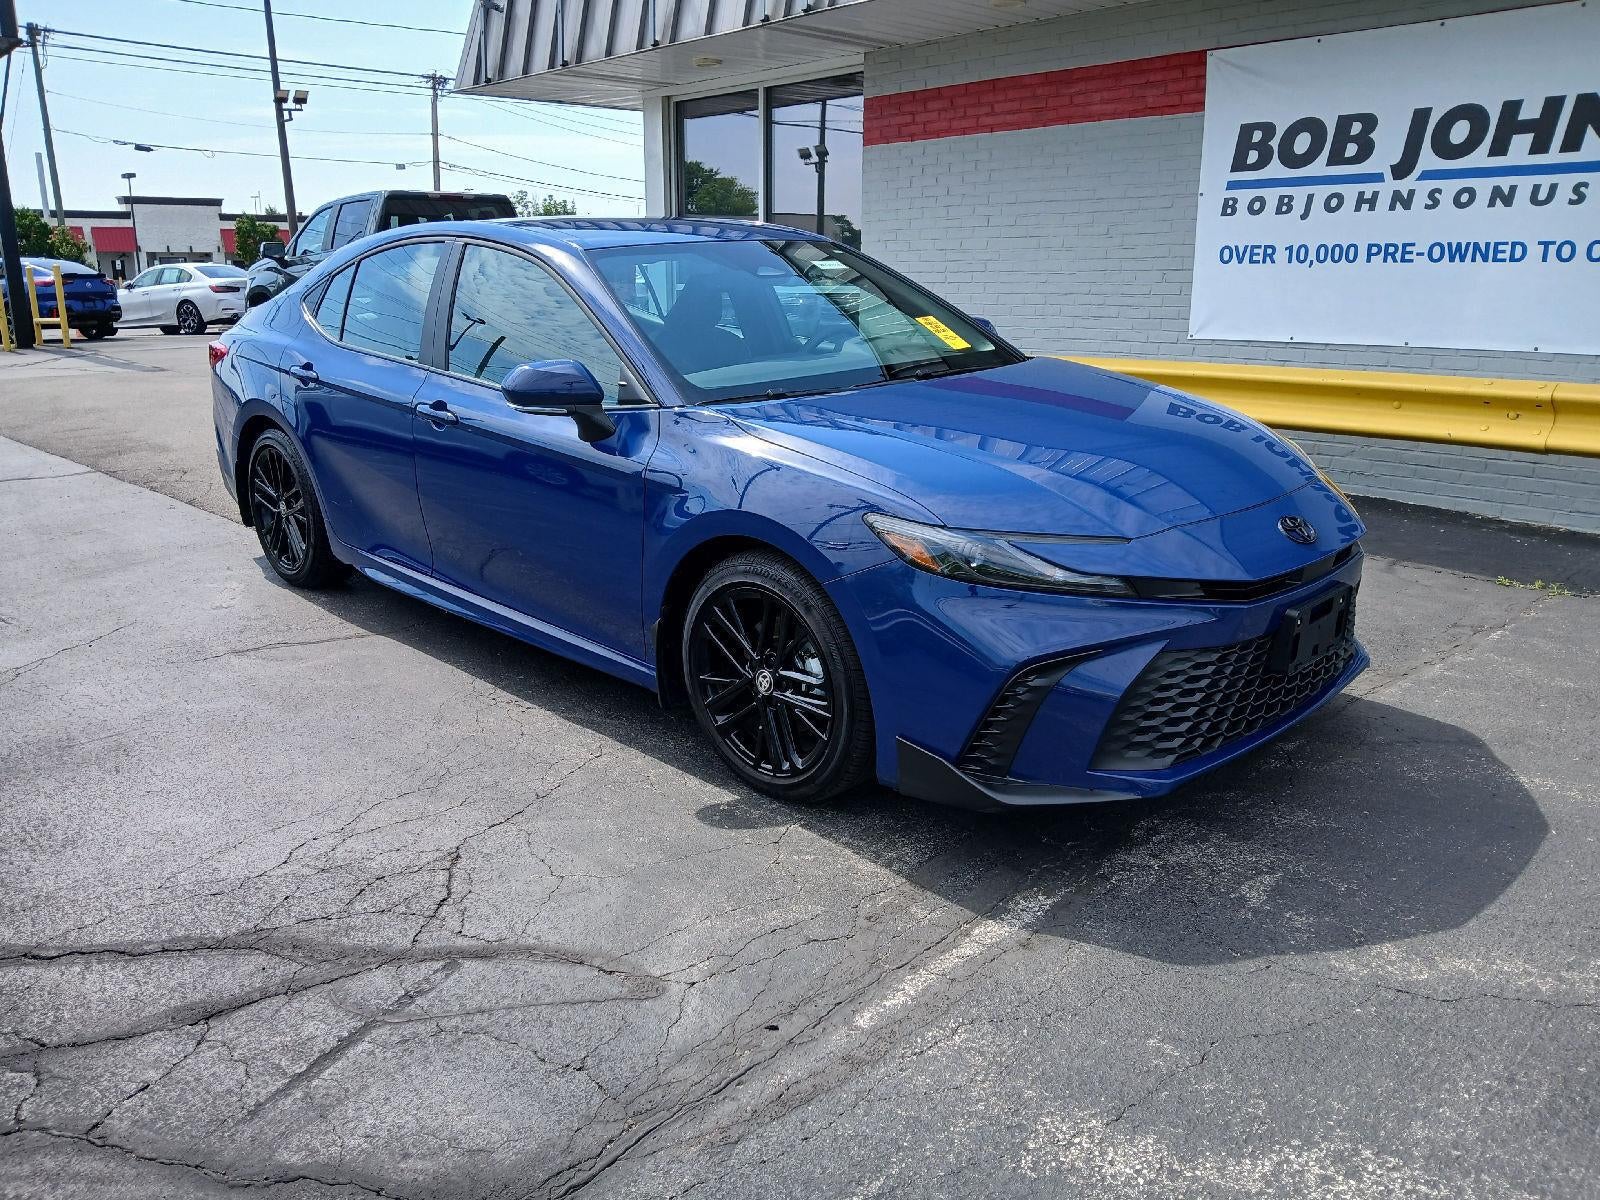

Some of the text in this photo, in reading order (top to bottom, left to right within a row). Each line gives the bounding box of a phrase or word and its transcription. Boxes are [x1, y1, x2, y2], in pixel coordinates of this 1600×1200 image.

[1229, 112, 1379, 173] BOB
[1219, 181, 1590, 221] BOBJOHNSONUS
[1219, 244, 1277, 265] OVER
[1284, 243, 1359, 268] 10,000
[1365, 241, 1528, 264] PRE-OWNED
[1537, 240, 1577, 263] TO
